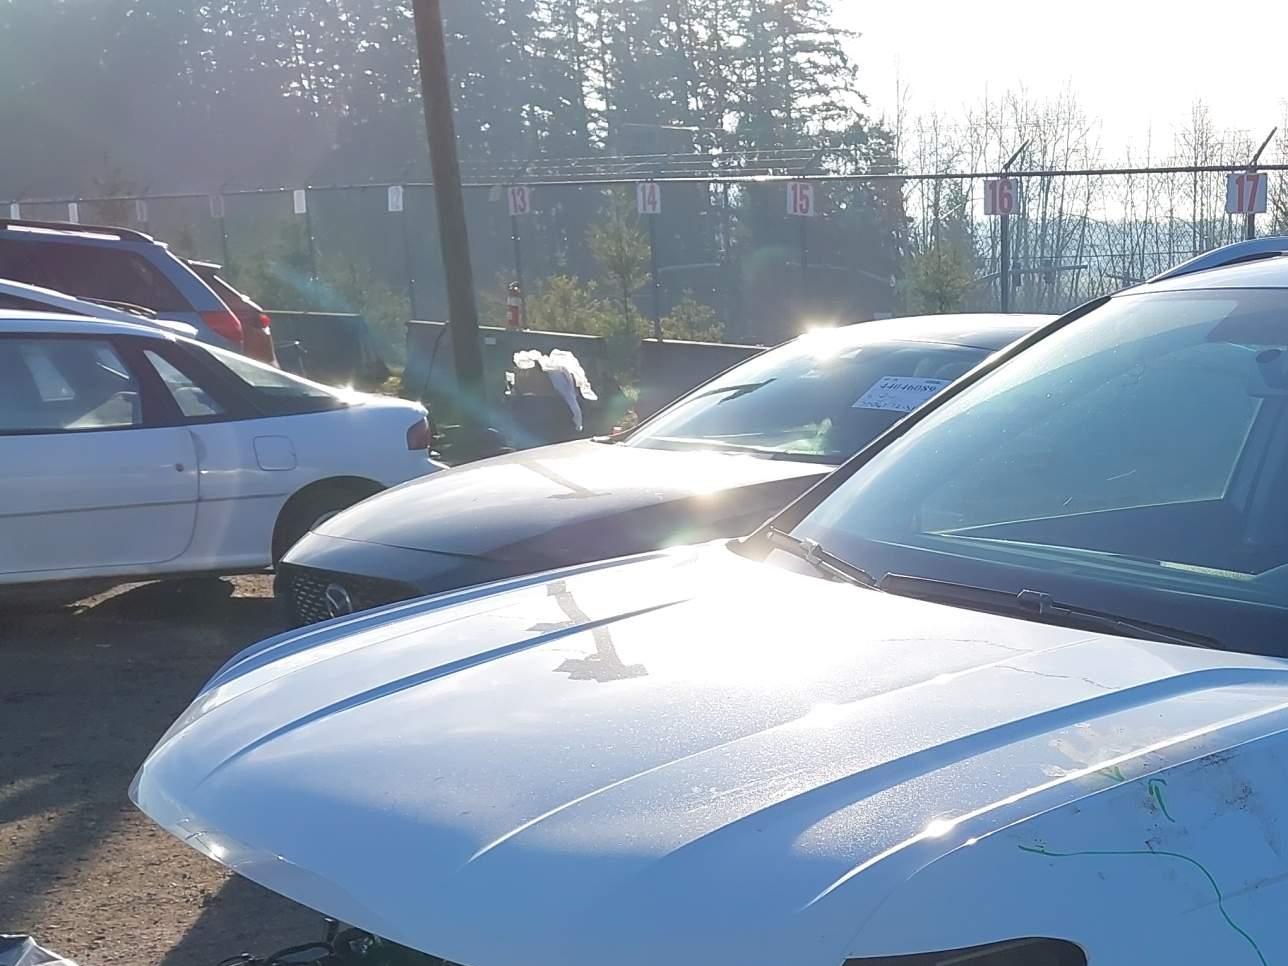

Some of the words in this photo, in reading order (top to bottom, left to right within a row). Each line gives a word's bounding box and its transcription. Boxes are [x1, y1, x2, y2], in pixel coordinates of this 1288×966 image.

[511, 186, 527, 213] 13
[639, 184, 657, 212] 14
[791, 183, 809, 214] 15
[988, 179, 1012, 214] 16
[1235, 174, 1259, 213] 17
